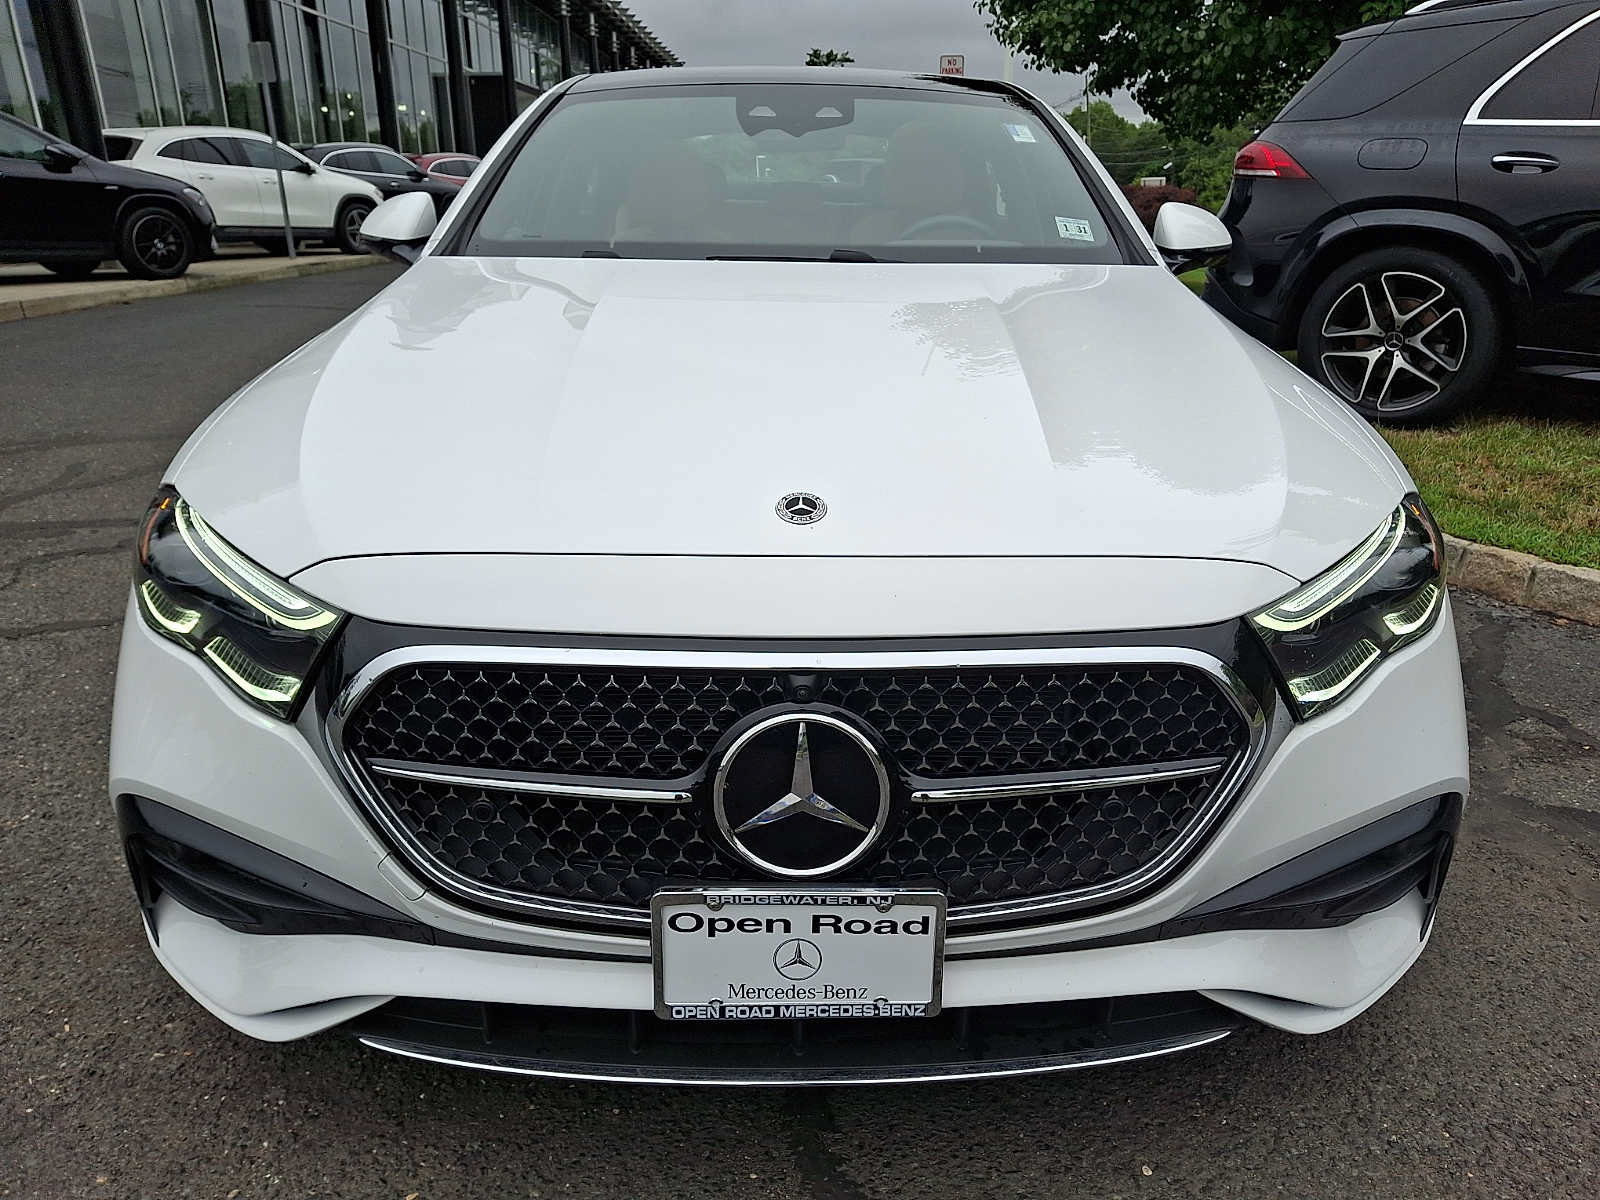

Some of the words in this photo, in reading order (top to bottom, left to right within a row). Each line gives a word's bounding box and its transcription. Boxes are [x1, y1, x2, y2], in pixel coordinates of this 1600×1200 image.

[947, 58, 957, 66] NO
[1063, 223, 1070, 232] 1
[1076, 225, 1088, 234] 31
[866, 895, 893, 905] NJ
[667, 912, 792, 938] Open
[811, 914, 930, 935] Road
[727, 983, 868, 999] Mercedes-Benz
[672, 1006, 720, 1018] OPEN
[725, 1006, 775, 1018] ROAD
